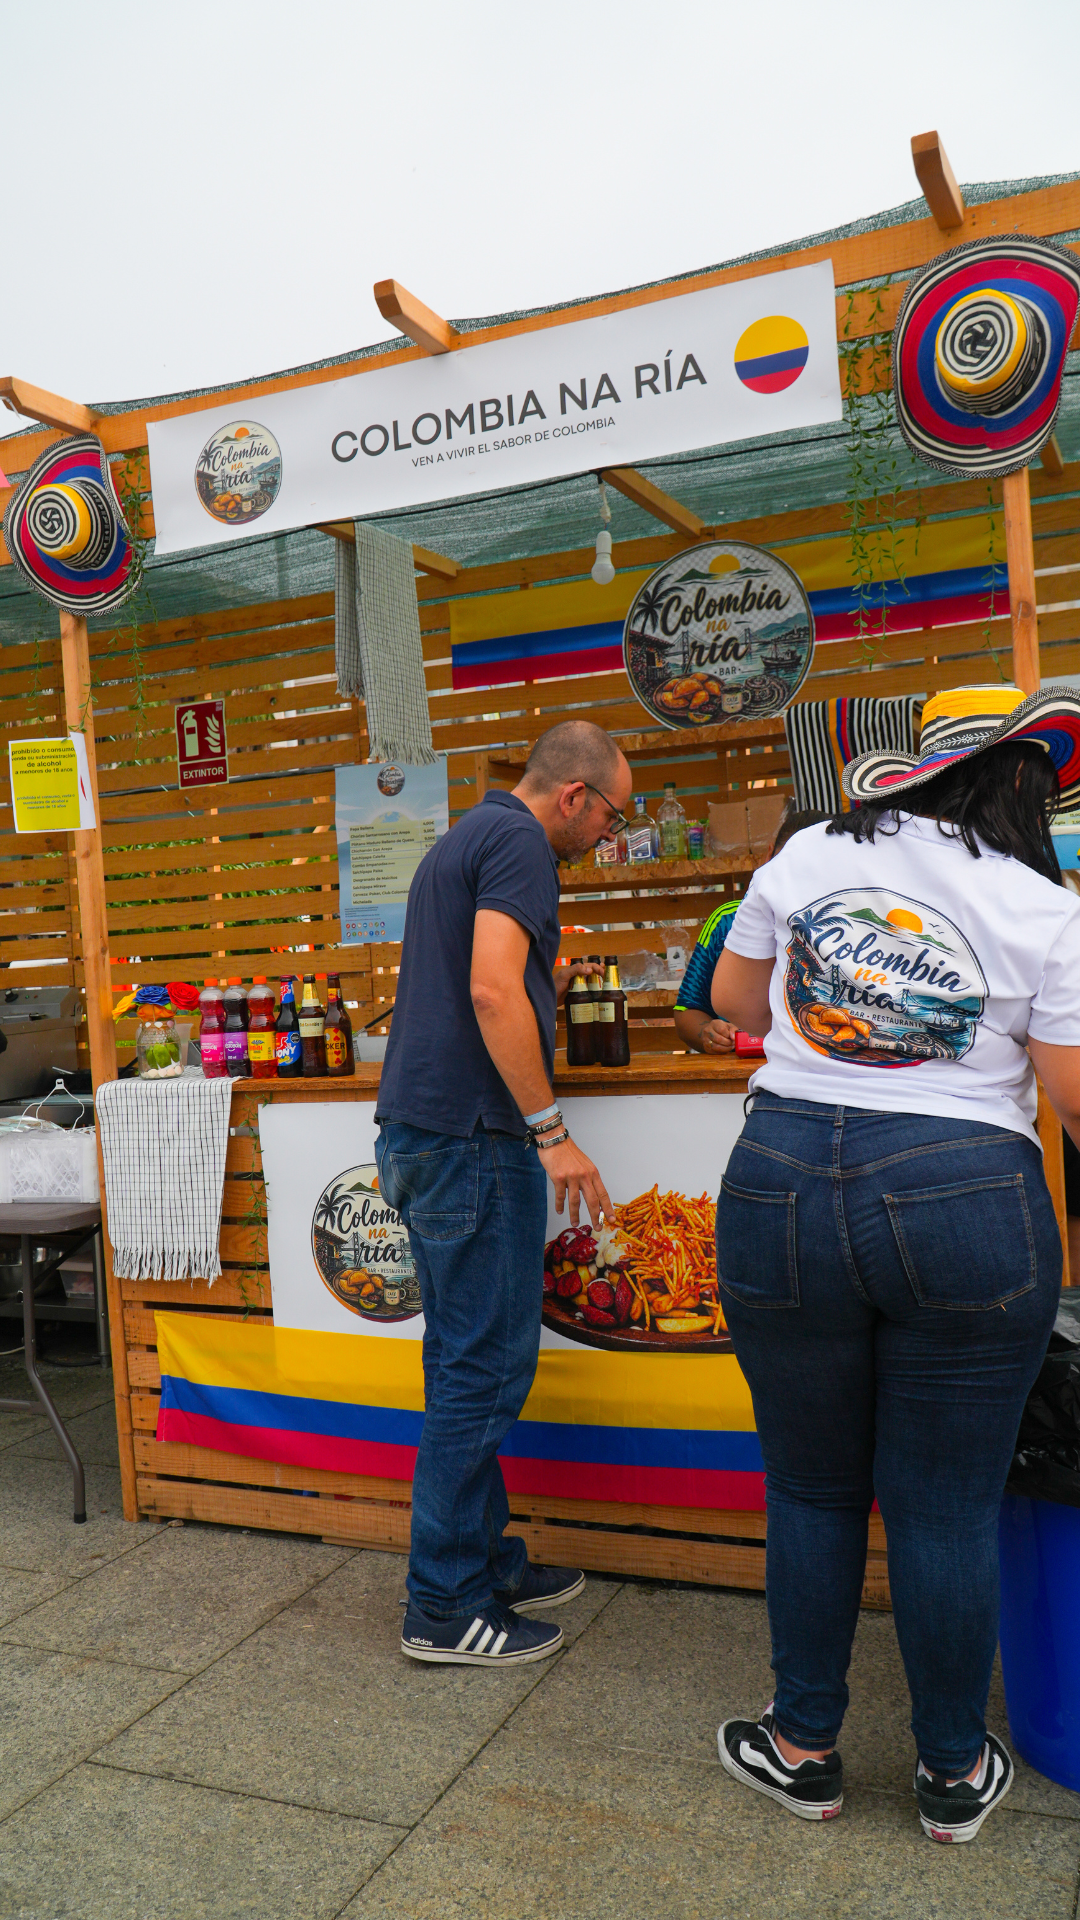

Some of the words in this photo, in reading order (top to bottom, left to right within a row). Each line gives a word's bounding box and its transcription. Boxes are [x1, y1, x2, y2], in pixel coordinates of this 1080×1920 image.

[331, 390, 546, 463] COLOMBIA
[559, 373, 621, 415] NA
[634, 349, 707, 399] RÍA
[411, 454, 434, 467] VEN
[436, 453, 444, 463] A
[446, 446, 475, 460] VIVIR
[478, 443, 490, 454] EL
[493, 434, 531, 451] SABOR
[535, 430, 550, 442] DE
[552, 416, 615, 438] COLOMBIA
[211, 440, 272, 472] Colombia
[231, 462, 244, 472] na
[225, 470, 252, 488] ría
[660, 580, 791, 636] Colombia
[706, 618, 731, 634] na
[686, 634, 752, 672] ría
[719, 667, 737, 676] BAR
[11, 748, 40, 756] prohibido
[183, 766, 224, 780] EXTINTOR
[813, 926, 971, 993] Colombia
[855, 967, 890, 986] na
[832, 980, 907, 1013] ría
[849, 1009, 865, 1019] BAR
[872, 1014, 923, 1029] RESTAURANTE
[325, 1042, 346, 1050] OKER
[336, 1198, 404, 1235] Colom
[368, 1227, 390, 1240] na
[358, 1240, 404, 1266] ría
[410, 1636, 433, 1647] adidas
